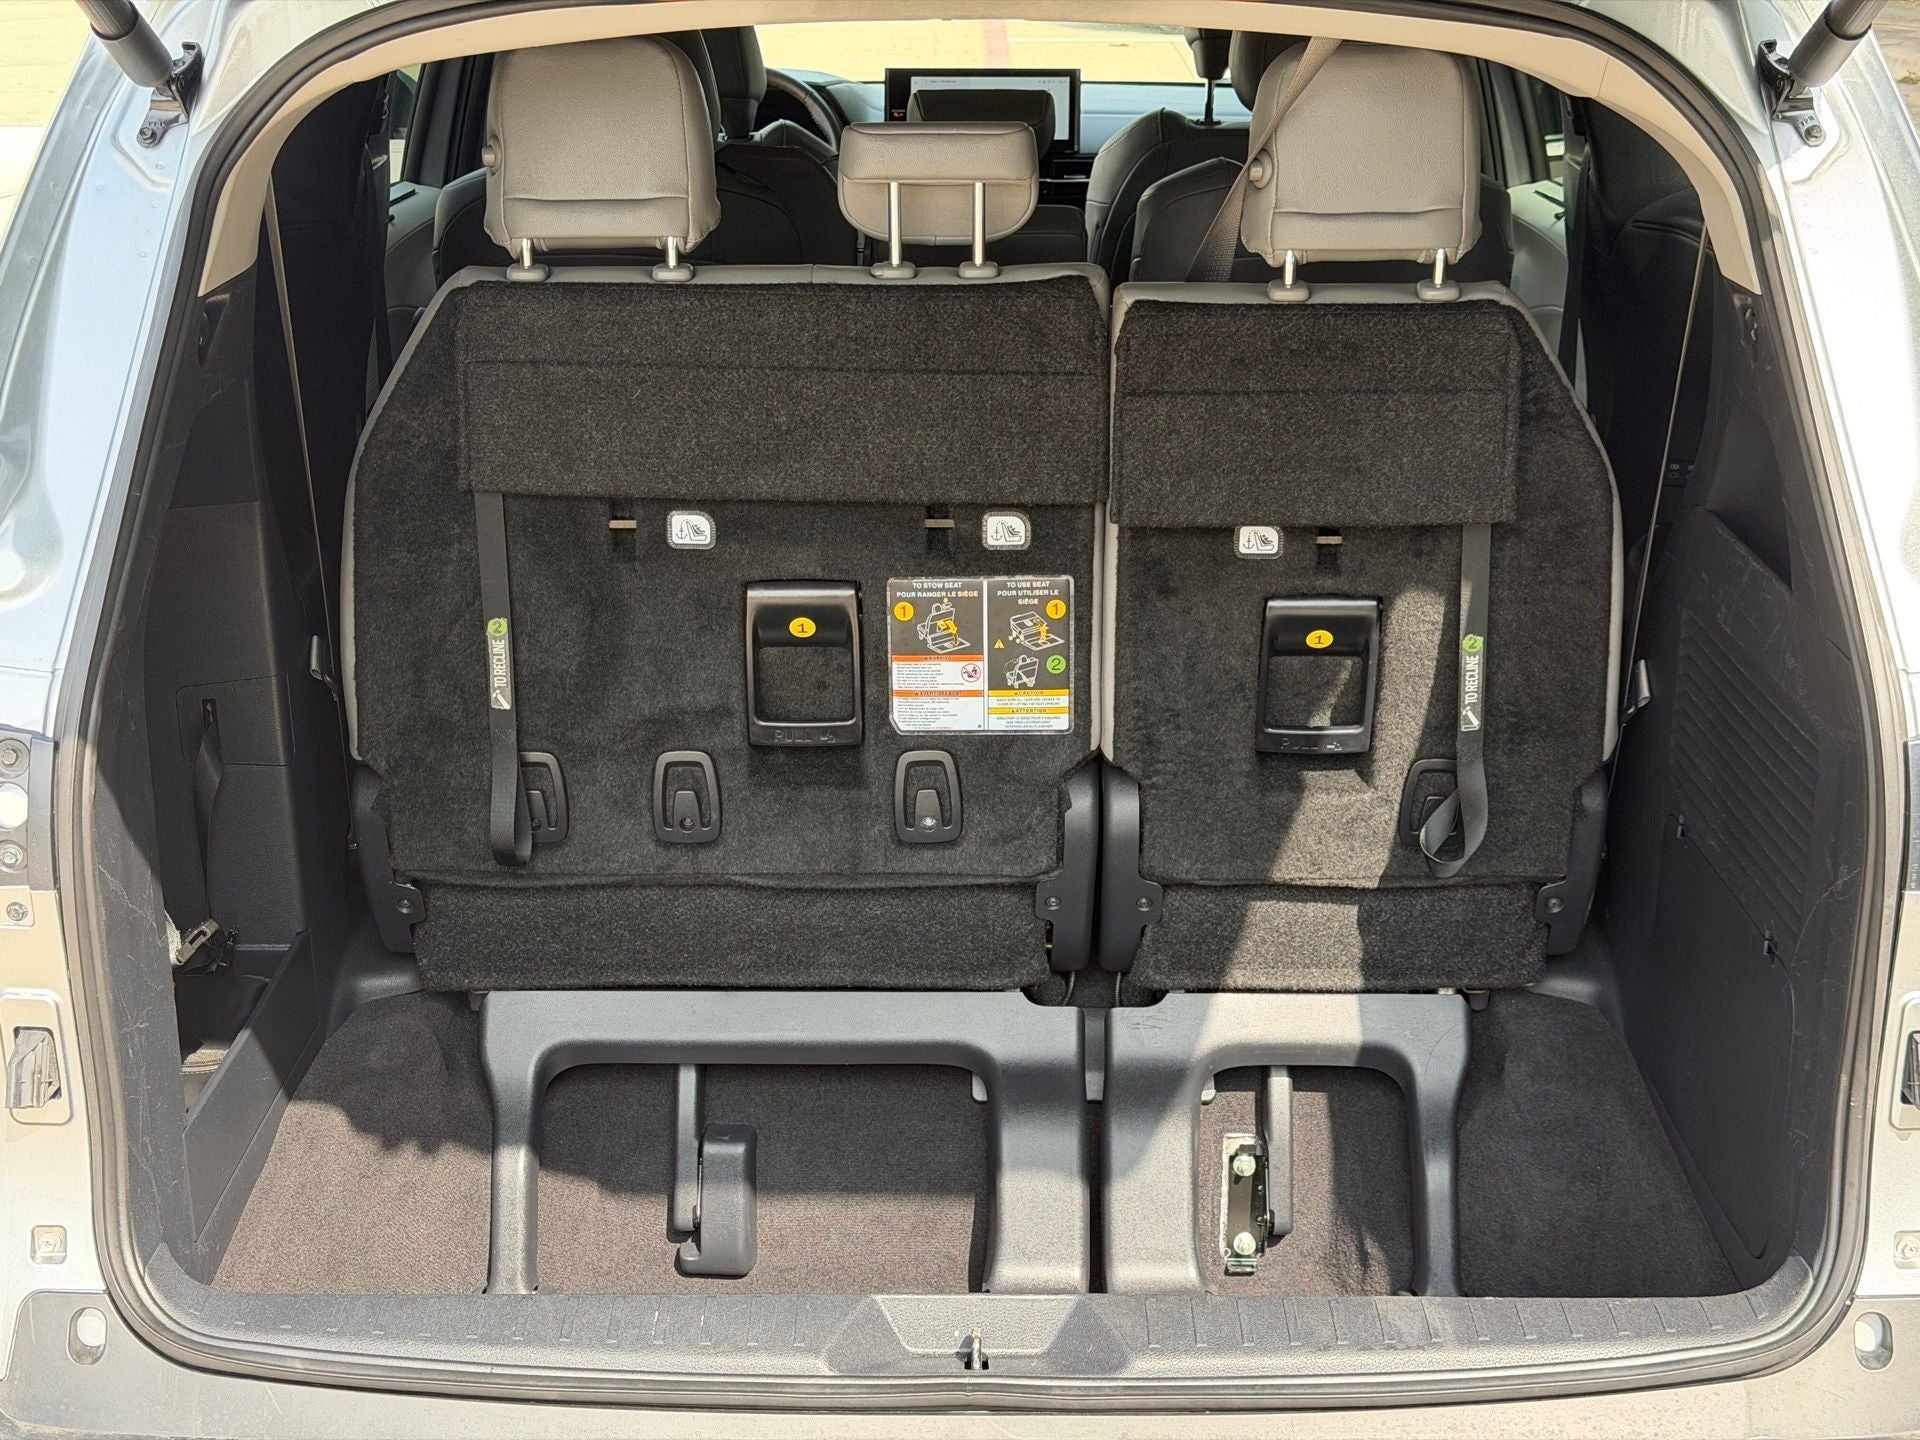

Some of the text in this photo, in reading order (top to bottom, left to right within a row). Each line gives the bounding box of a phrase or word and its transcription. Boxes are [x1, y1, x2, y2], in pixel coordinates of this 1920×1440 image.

[492, 621, 502, 634] 2
[797, 622, 808, 634] 1
[1313, 634, 1325, 645] 1
[1468, 636, 1477, 649] 2
[492, 639, 507, 688] TO RECLINE
[1051, 657, 1061, 671] 2
[1464, 655, 1479, 705] TO RECLINE
[774, 730, 812, 743] PULL
